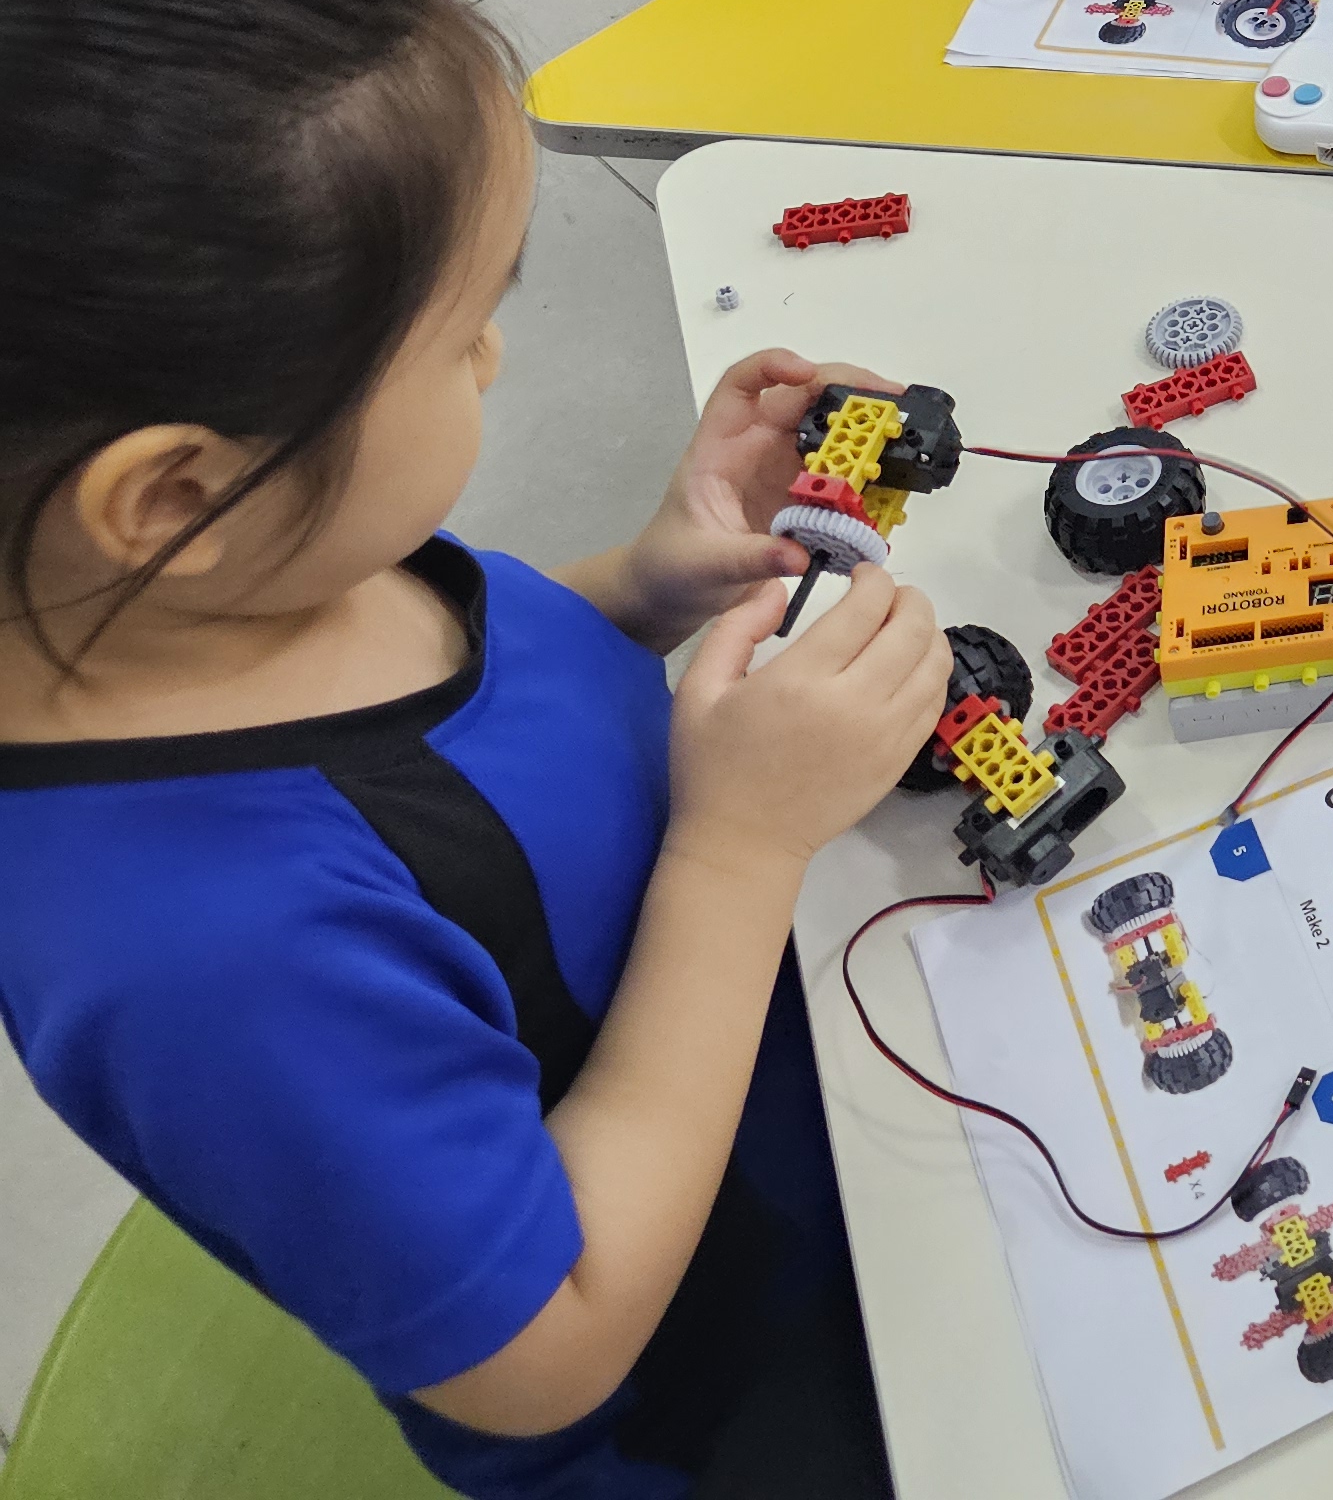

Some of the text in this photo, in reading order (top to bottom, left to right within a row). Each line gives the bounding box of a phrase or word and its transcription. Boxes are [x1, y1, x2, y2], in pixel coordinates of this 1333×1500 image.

[1223, 587, 1270, 600] TORIANO
[1201, 594, 1286, 616] ROBOTORI
[1233, 845, 1247, 857] 5
[1300, 899, 1330, 949] Make 2
